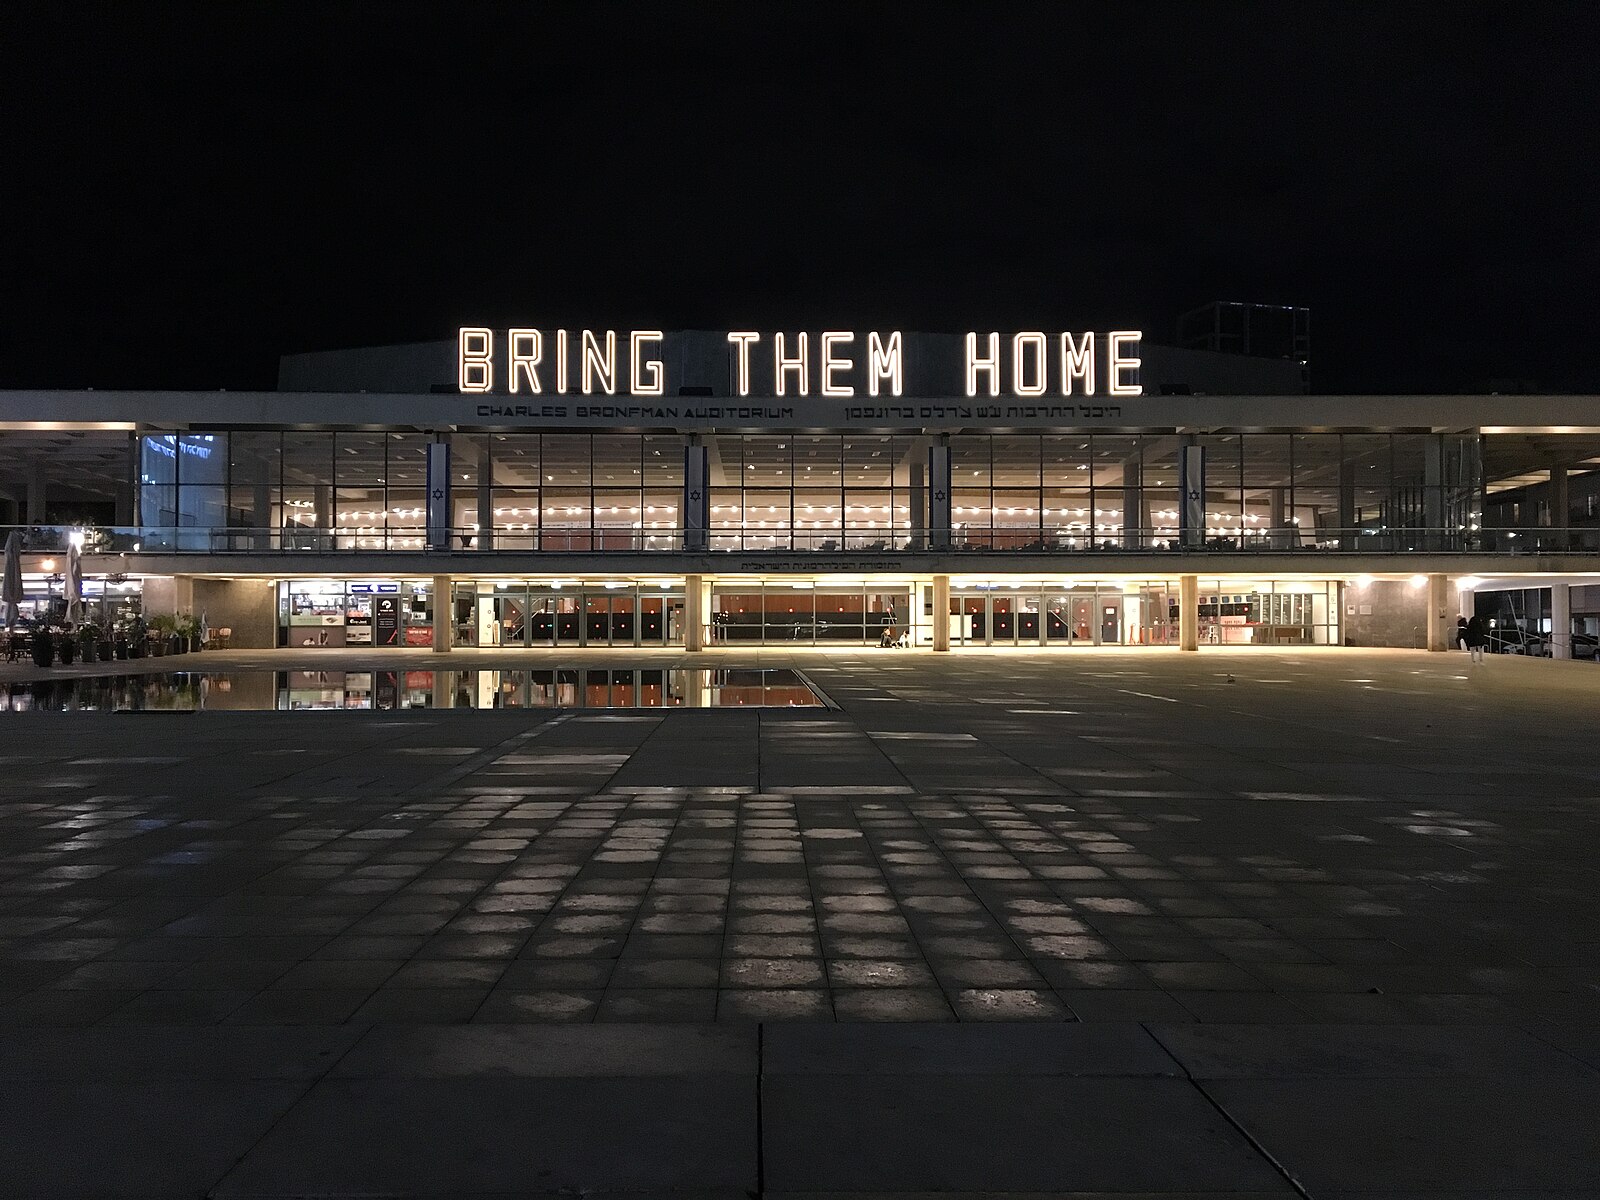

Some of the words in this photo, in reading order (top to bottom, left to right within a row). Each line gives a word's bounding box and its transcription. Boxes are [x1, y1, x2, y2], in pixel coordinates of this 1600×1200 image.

[458, 327, 664, 396] BRING
[727, 331, 903, 397] THEM
[965, 331, 1143, 397] HOME
[476, 405, 568, 418] CHARLES
[576, 406, 679, 418] BRONFMAN
[683, 407, 794, 419] AUDITORIUM
[844, 406, 915, 421] ברונפמן
[1006, 406, 1075, 418] התרבות
[1079, 404, 1121, 418] היכל
